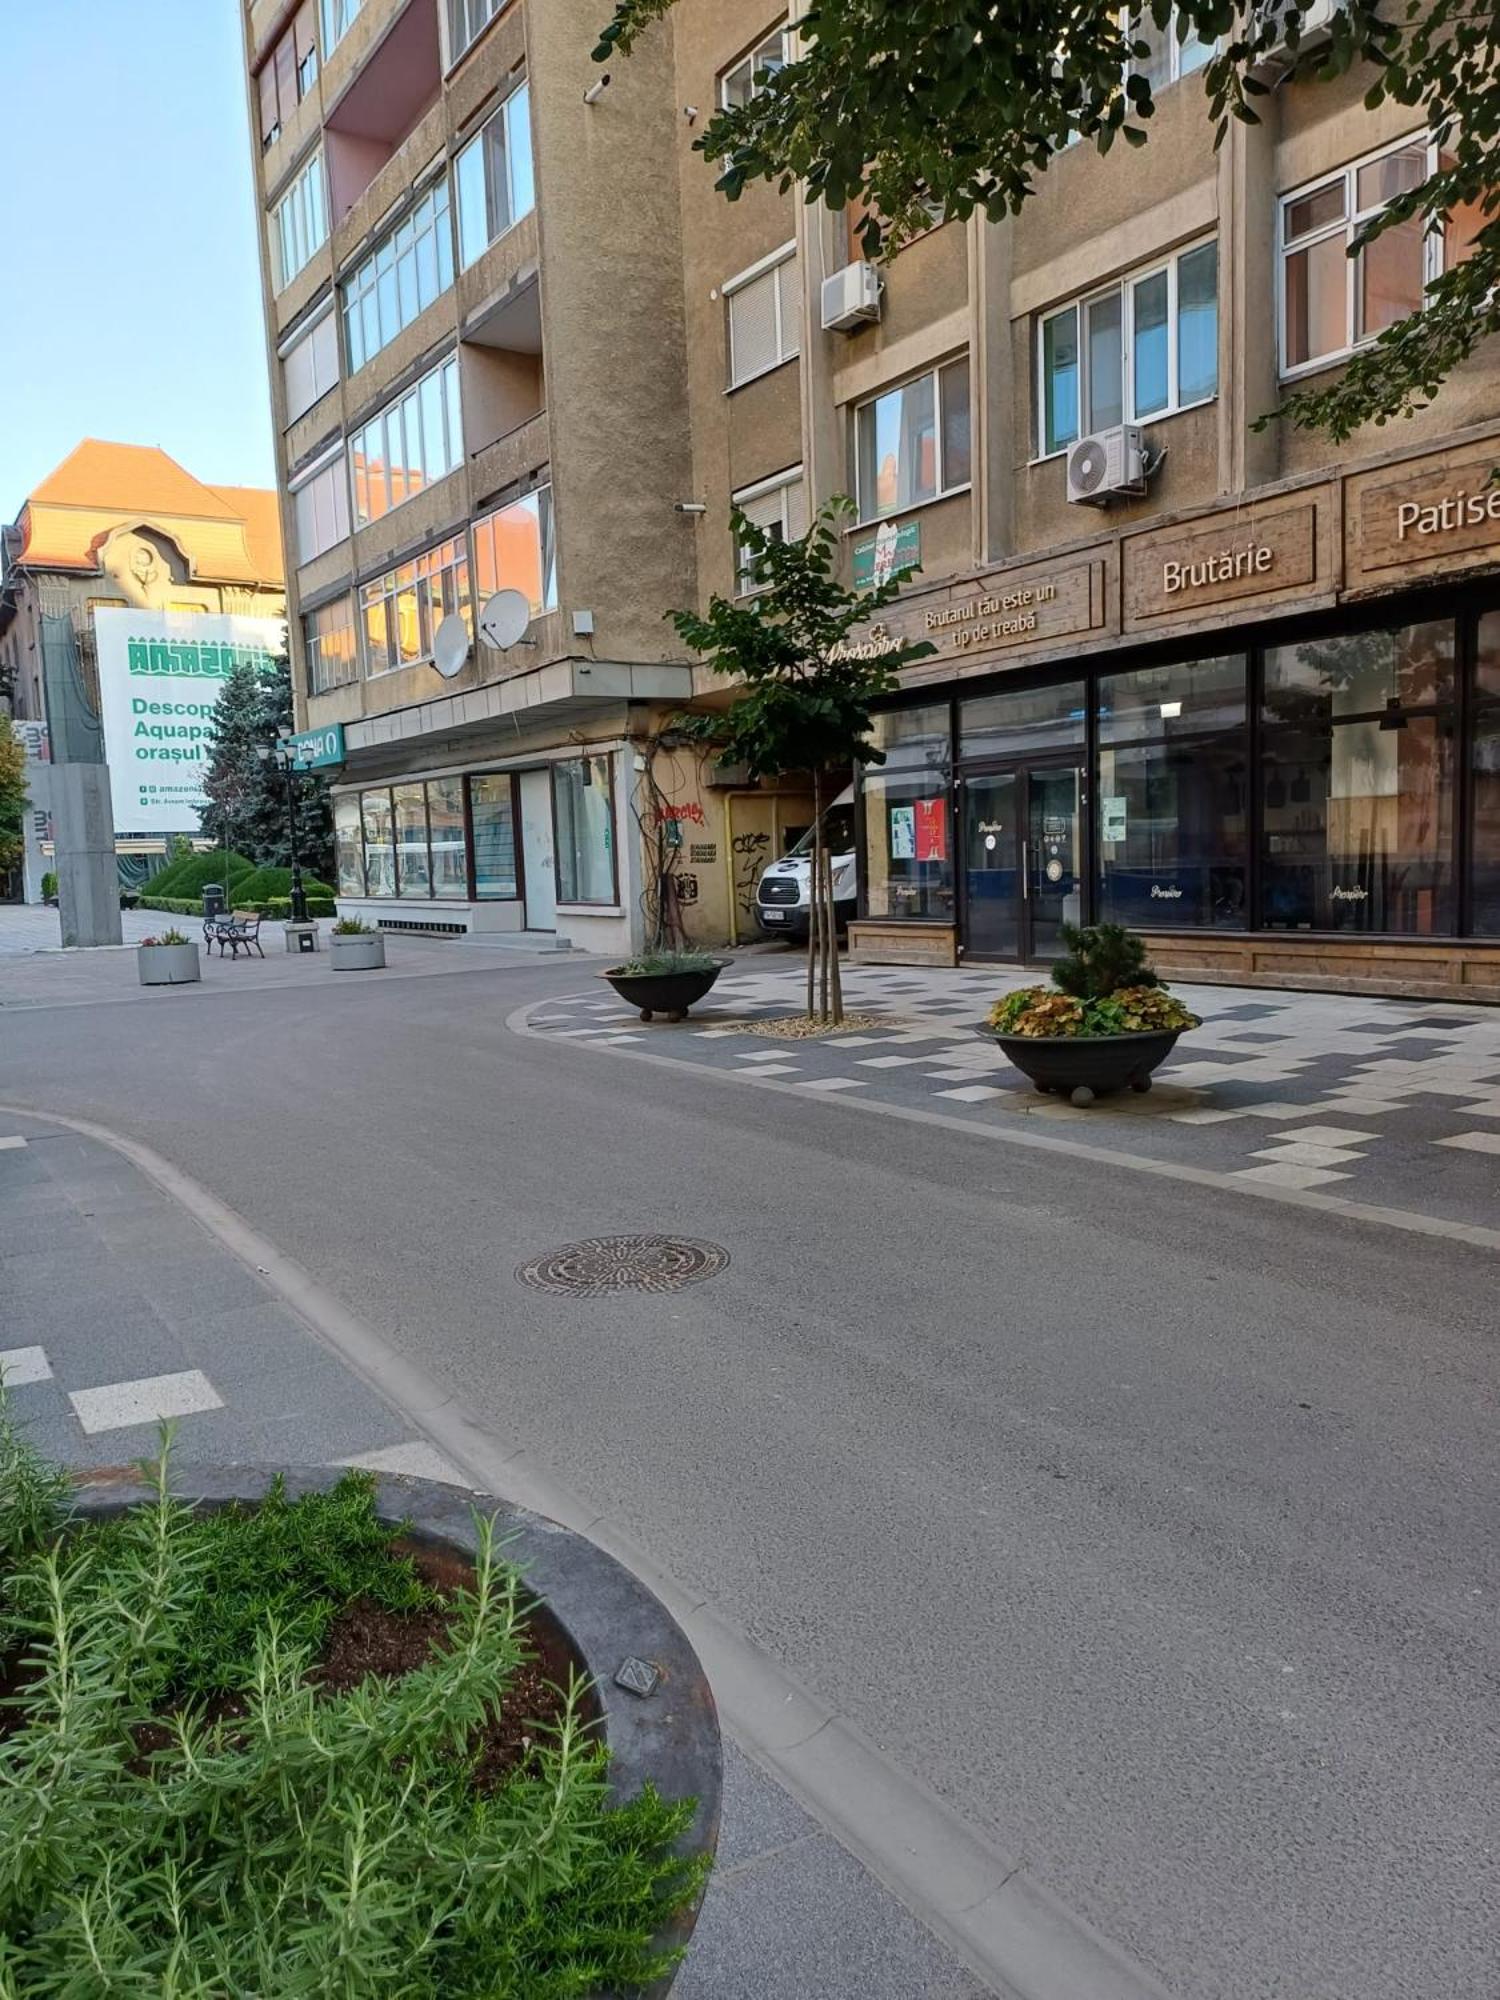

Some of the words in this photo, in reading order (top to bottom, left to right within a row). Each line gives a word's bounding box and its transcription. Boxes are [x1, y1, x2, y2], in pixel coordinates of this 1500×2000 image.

[1163, 543, 1272, 593] Brutărie
[924, 603, 975, 630] Brutarul
[978, 597, 1000, 615] tău
[1002, 590, 1032, 610] este
[1036, 584, 1055, 601] un
[952, 632, 970, 648] tip
[972, 625, 991, 642] de
[992, 612, 1037, 637] treabă
